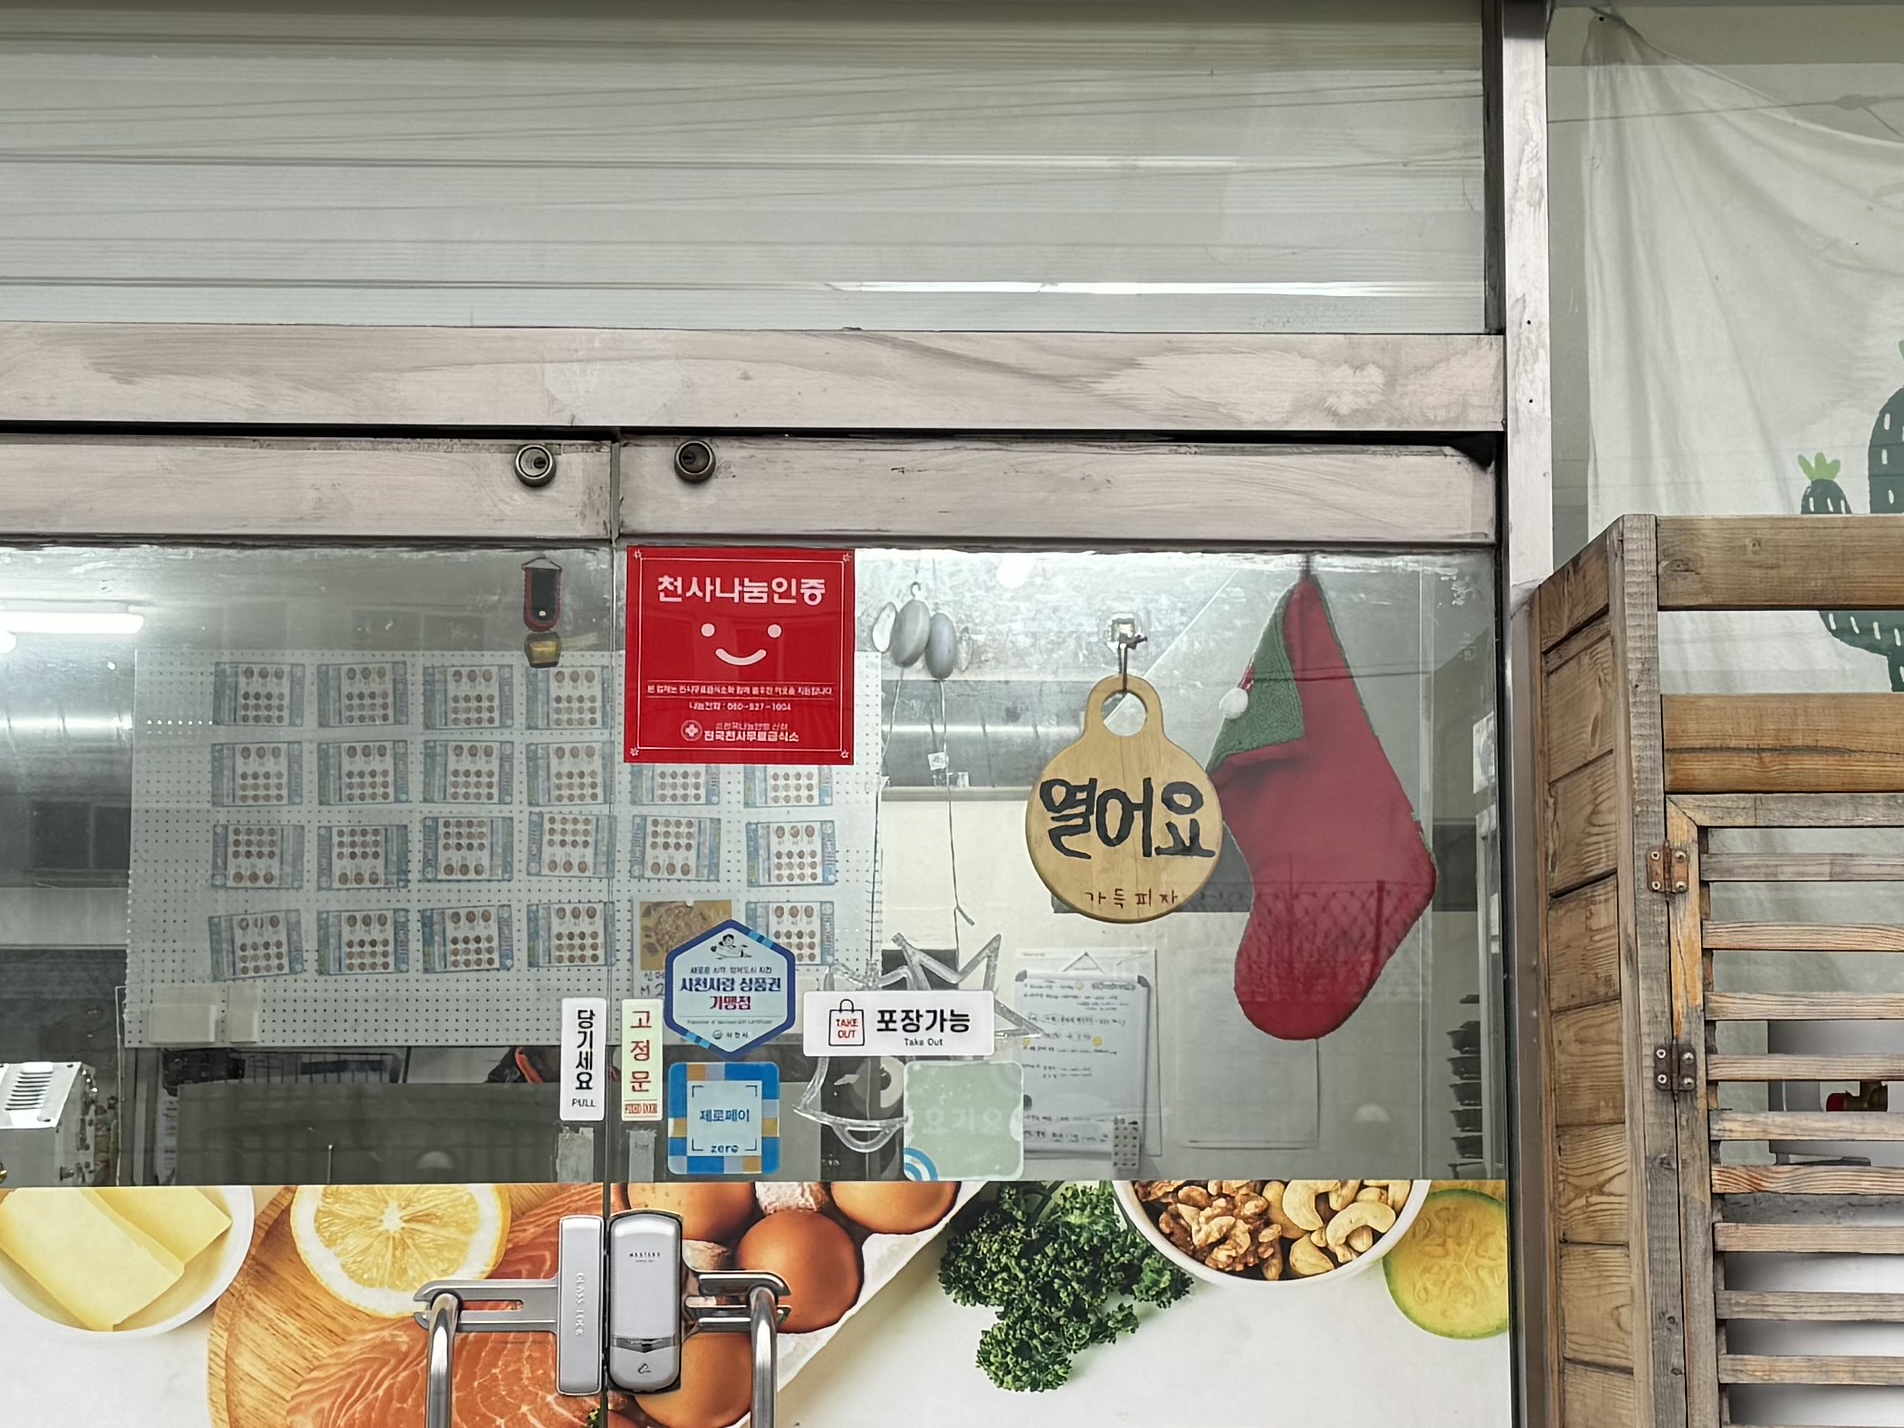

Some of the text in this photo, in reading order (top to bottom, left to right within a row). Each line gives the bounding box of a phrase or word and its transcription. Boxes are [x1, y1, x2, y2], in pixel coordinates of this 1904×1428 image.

[657, 574, 827, 606] 천사나눔인증
[1039, 776, 1216, 860] 열어요
[1083, 888, 1179, 909] 가득피자
[679, 977, 735, 992] 사천사랑
[709, 995, 752, 1010] 가맹점
[876, 1008, 971, 1033] 포장가능
[575, 1009, 597, 1090] 당기세요
[629, 1010, 652, 1092] 고정문
[571, 1098, 597, 1108] PULL
[699, 1109, 750, 1122] 제로페이
